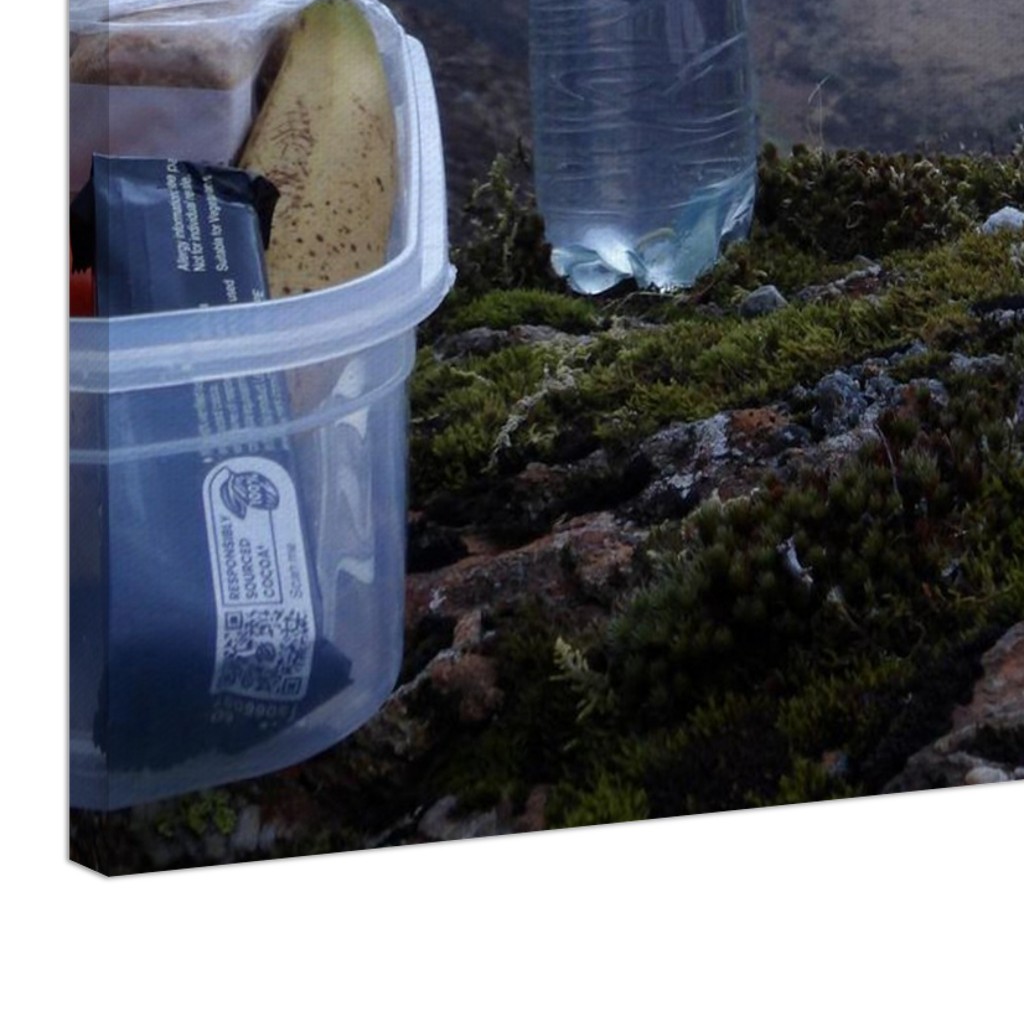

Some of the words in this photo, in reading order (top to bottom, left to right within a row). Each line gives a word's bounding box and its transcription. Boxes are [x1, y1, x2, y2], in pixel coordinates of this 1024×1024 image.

[184, 201, 201, 240] individual
[210, 223, 222, 237] for
[176, 239, 191, 272] Allergy
[190, 241, 204, 255] for
[193, 255, 206, 272] Not
[212, 237, 229, 272] Suitable
[223, 279, 238, 303] used
[246, 473, 263, 507] 100%
[221, 516, 240, 600] RESPONSIBLY
[239, 537, 258, 599] SOURCED
[287, 563, 303, 599] Scan
